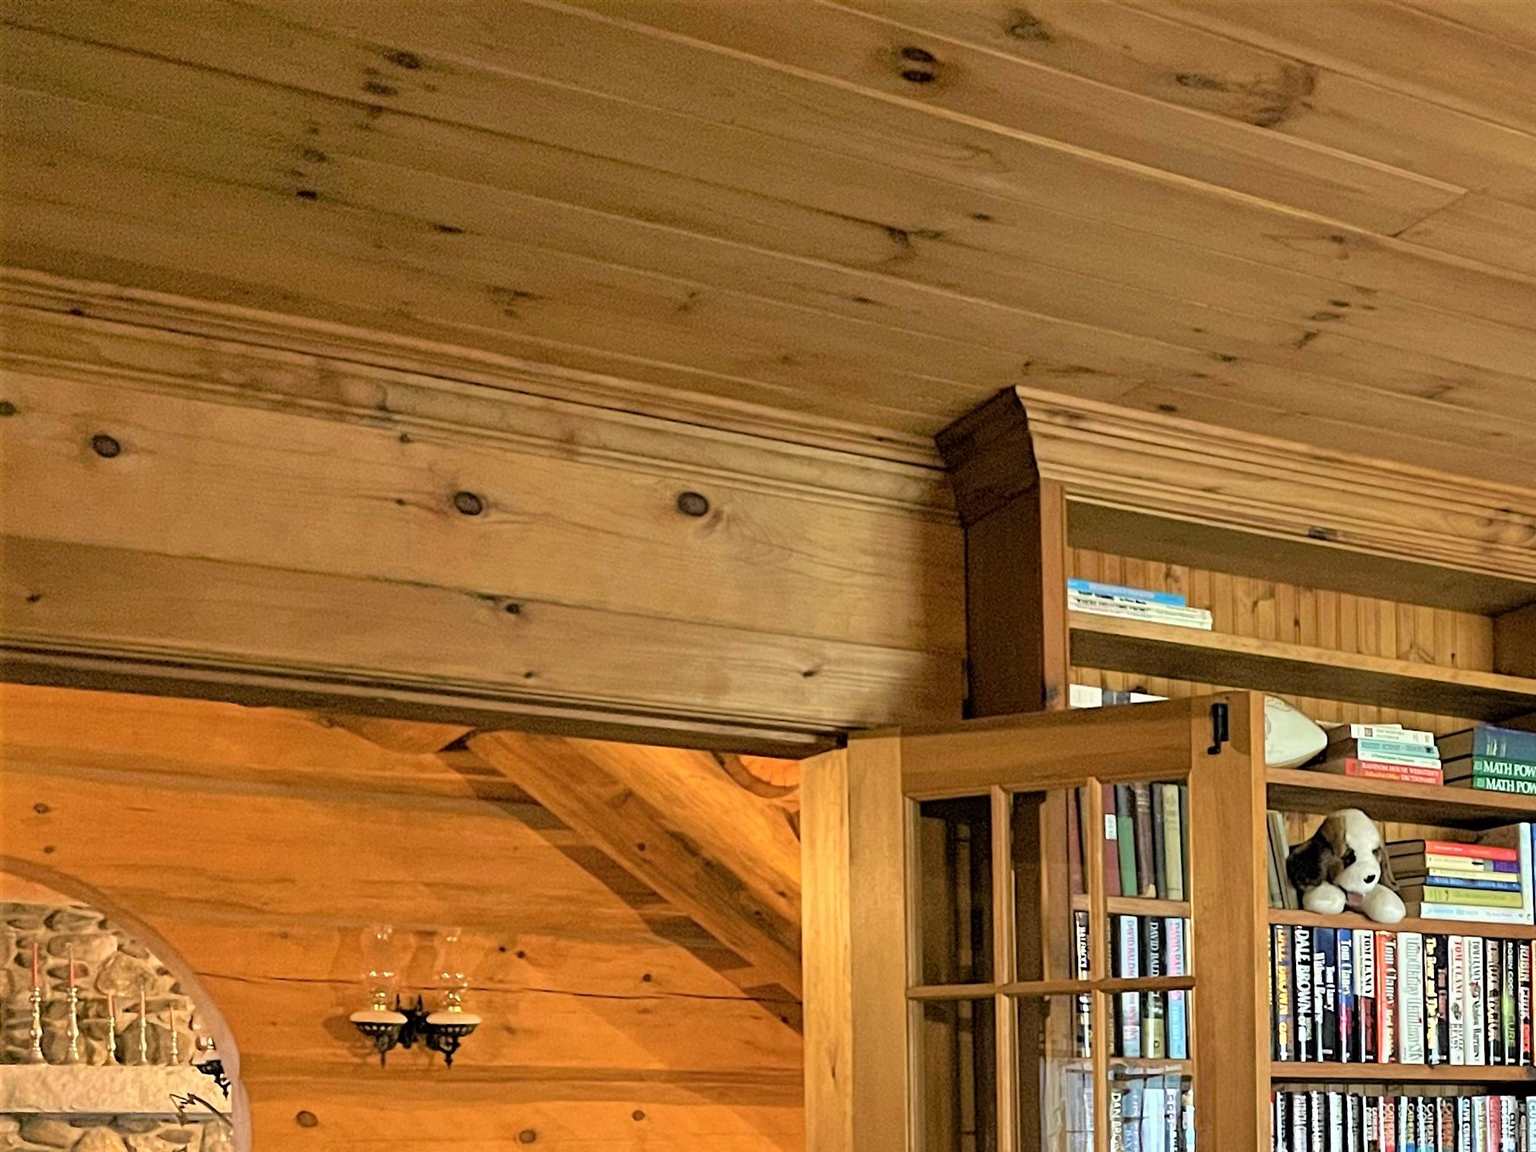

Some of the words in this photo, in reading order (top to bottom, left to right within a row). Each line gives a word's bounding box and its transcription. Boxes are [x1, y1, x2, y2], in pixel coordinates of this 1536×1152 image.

[1483, 760, 1513, 776] MATH
[1486, 777, 1515, 792] MATH
[1151, 922, 1160, 951] DAVID
[1295, 929, 1311, 962] DALE
[1340, 939, 1352, 961] Tom
[1363, 935, 1373, 956] TOM
[1384, 939, 1398, 966] Tom
[1455, 941, 1464, 962] TOM
[1520, 944, 1530, 981] ROBIN
[1297, 963, 1311, 1014] BROWN
[1339, 962, 1352, 996] Clancy
[1363, 957, 1373, 995] CLANCY
[1384, 967, 1398, 1006] Clancy
[1278, 965, 1289, 1016] BROWN
[1110, 1092, 1121, 1117] DAN
[1463, 1098, 1471, 1121] CLIVE
[1509, 1112, 1517, 1139] CLIVE
